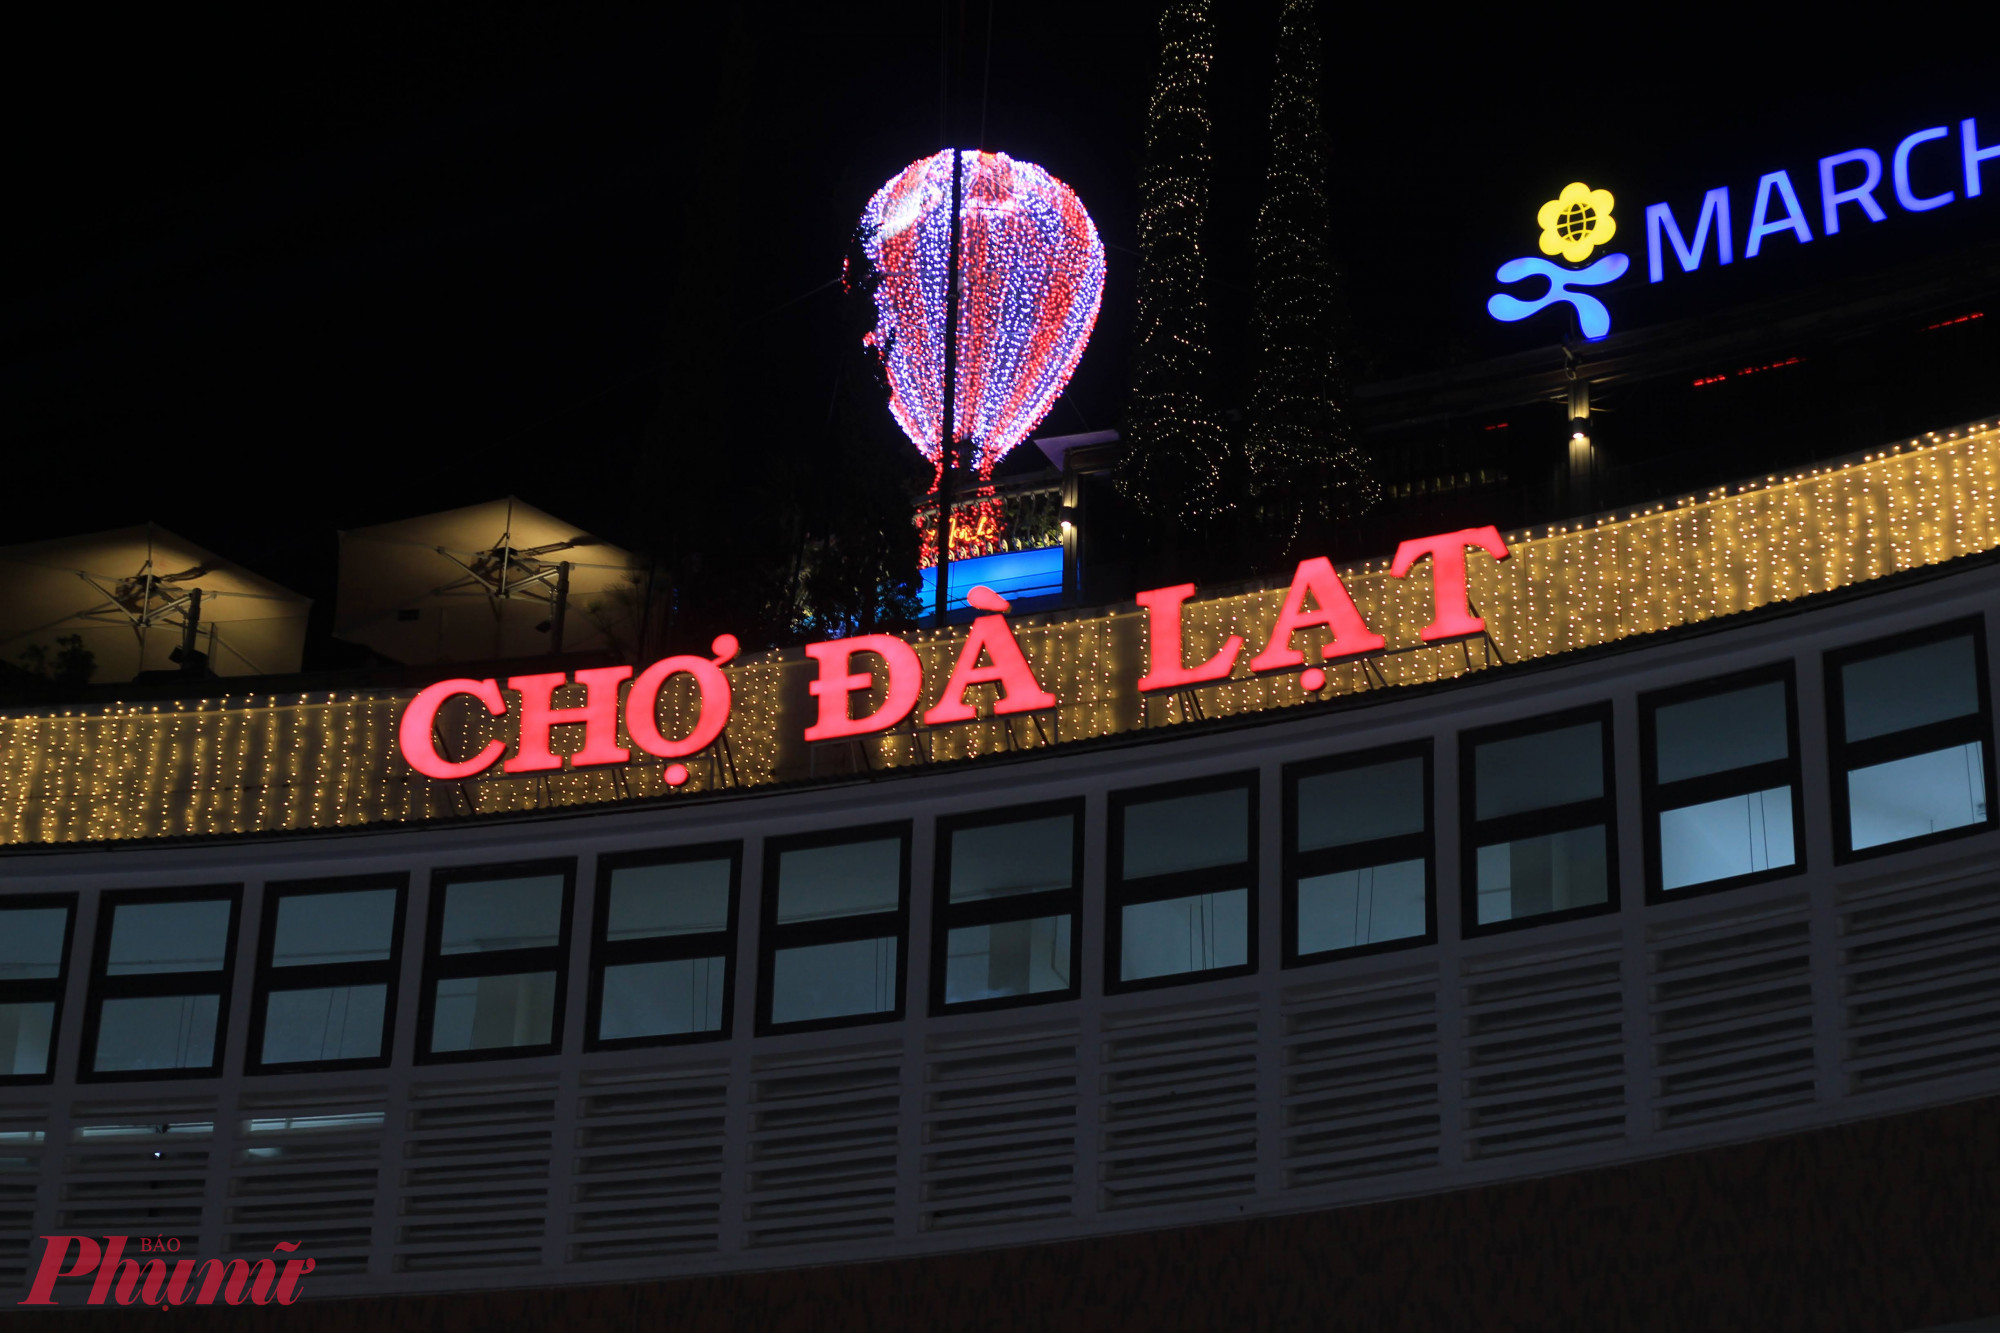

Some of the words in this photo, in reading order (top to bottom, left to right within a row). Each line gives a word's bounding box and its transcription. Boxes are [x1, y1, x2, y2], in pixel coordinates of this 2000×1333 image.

[1645, 117, 2000, 283] MARCH
[399, 634, 739, 786] CHỢ
[804, 585, 1057, 742] ĐÀ
[1136, 525, 1509, 691] LẠT
